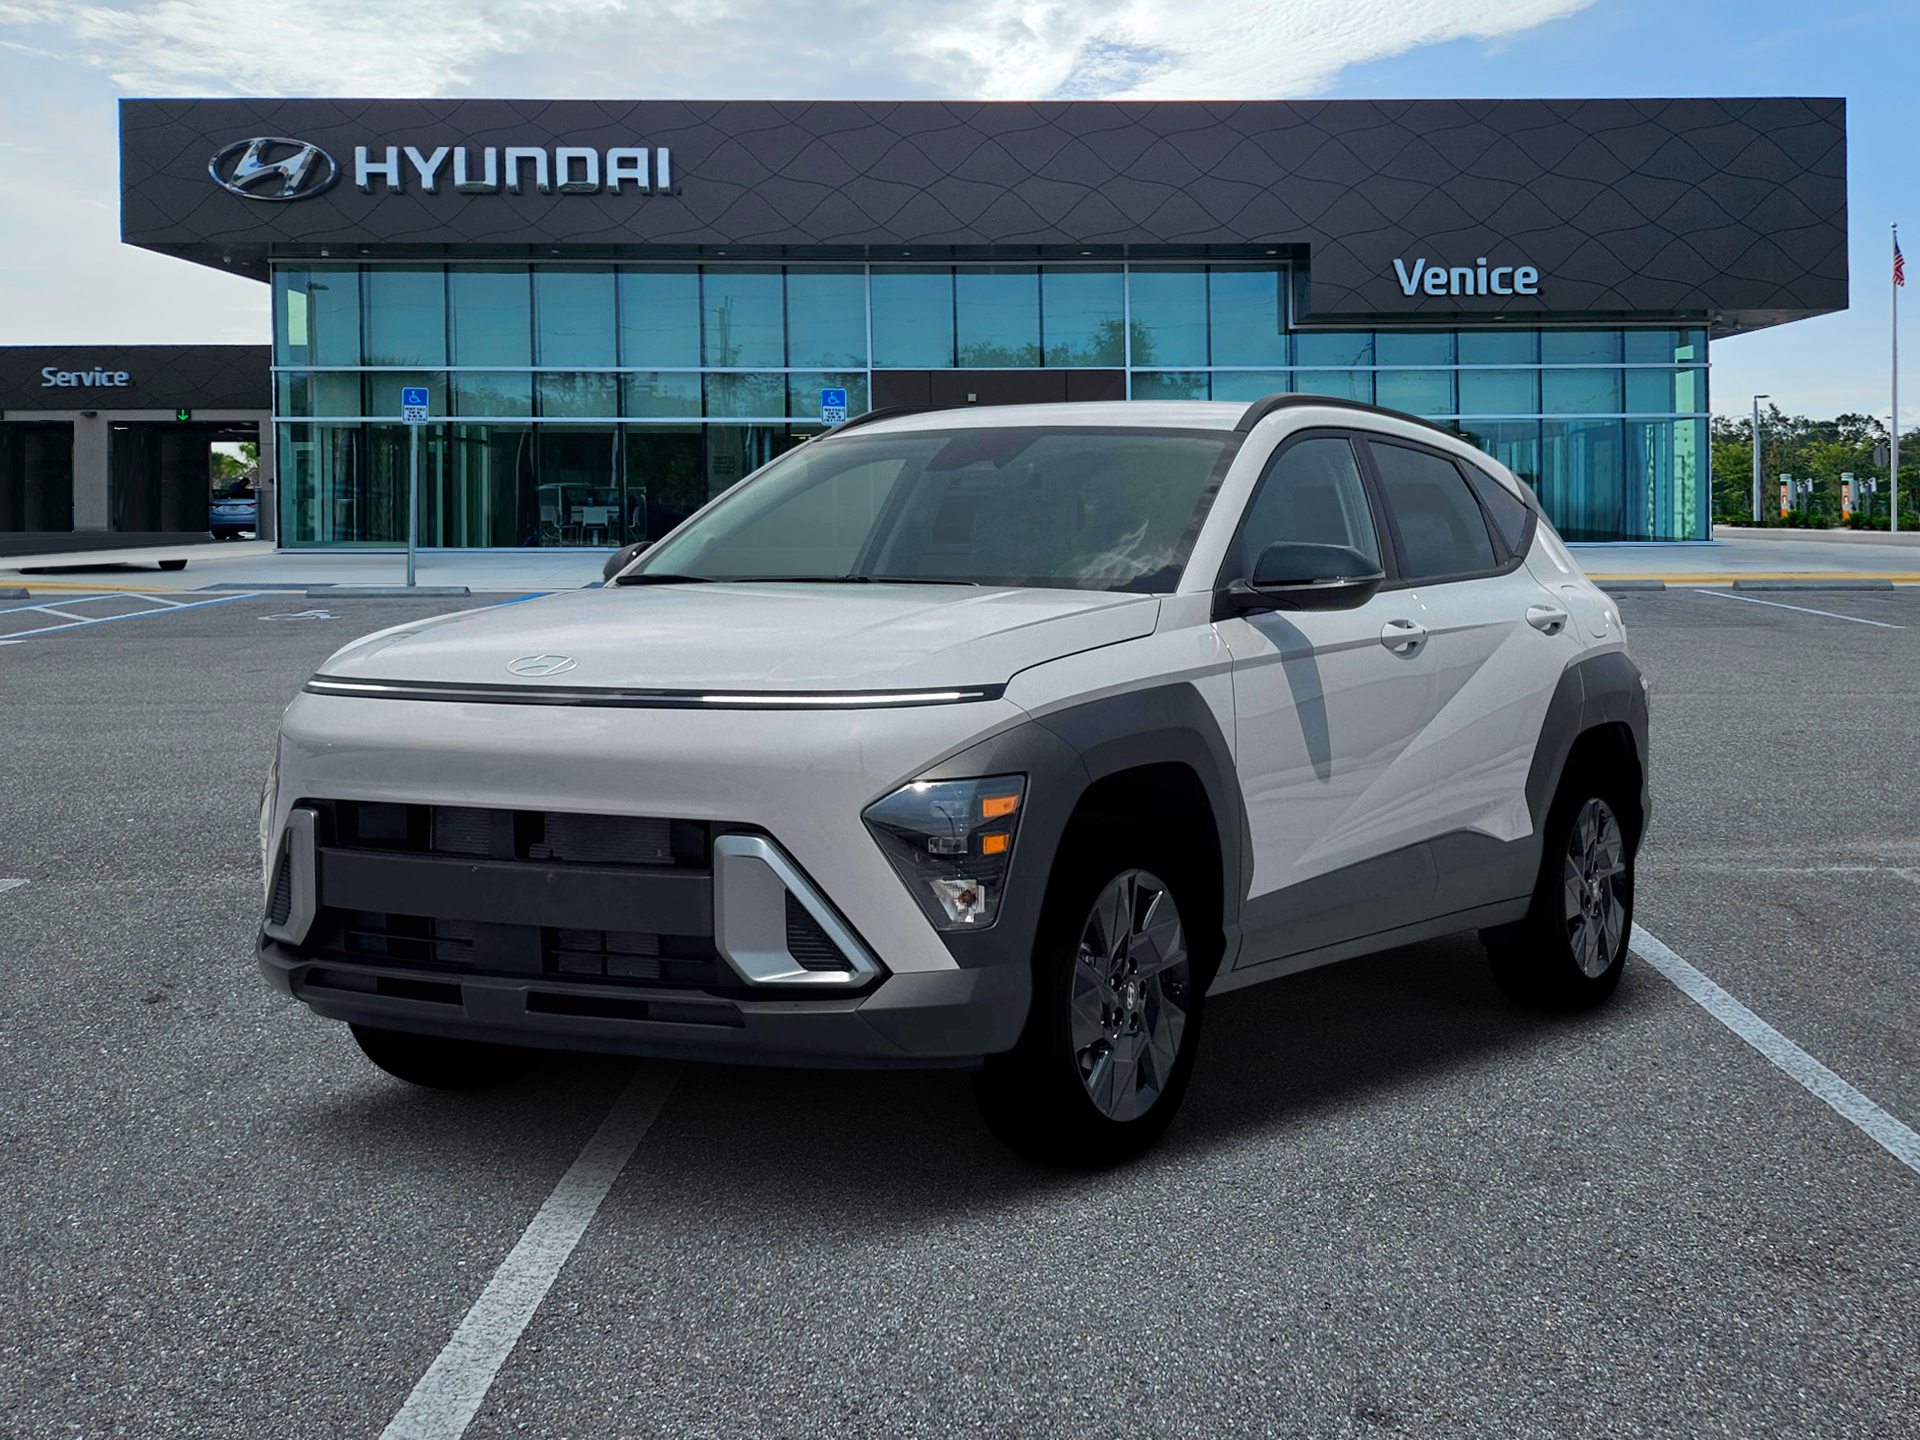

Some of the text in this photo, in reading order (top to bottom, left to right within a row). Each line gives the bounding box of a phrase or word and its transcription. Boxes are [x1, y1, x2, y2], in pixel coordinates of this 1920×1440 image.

[354, 146, 671, 193] HYUNDAI
[1392, 257, 1539, 296] Venice
[41, 366, 130, 387] Service
